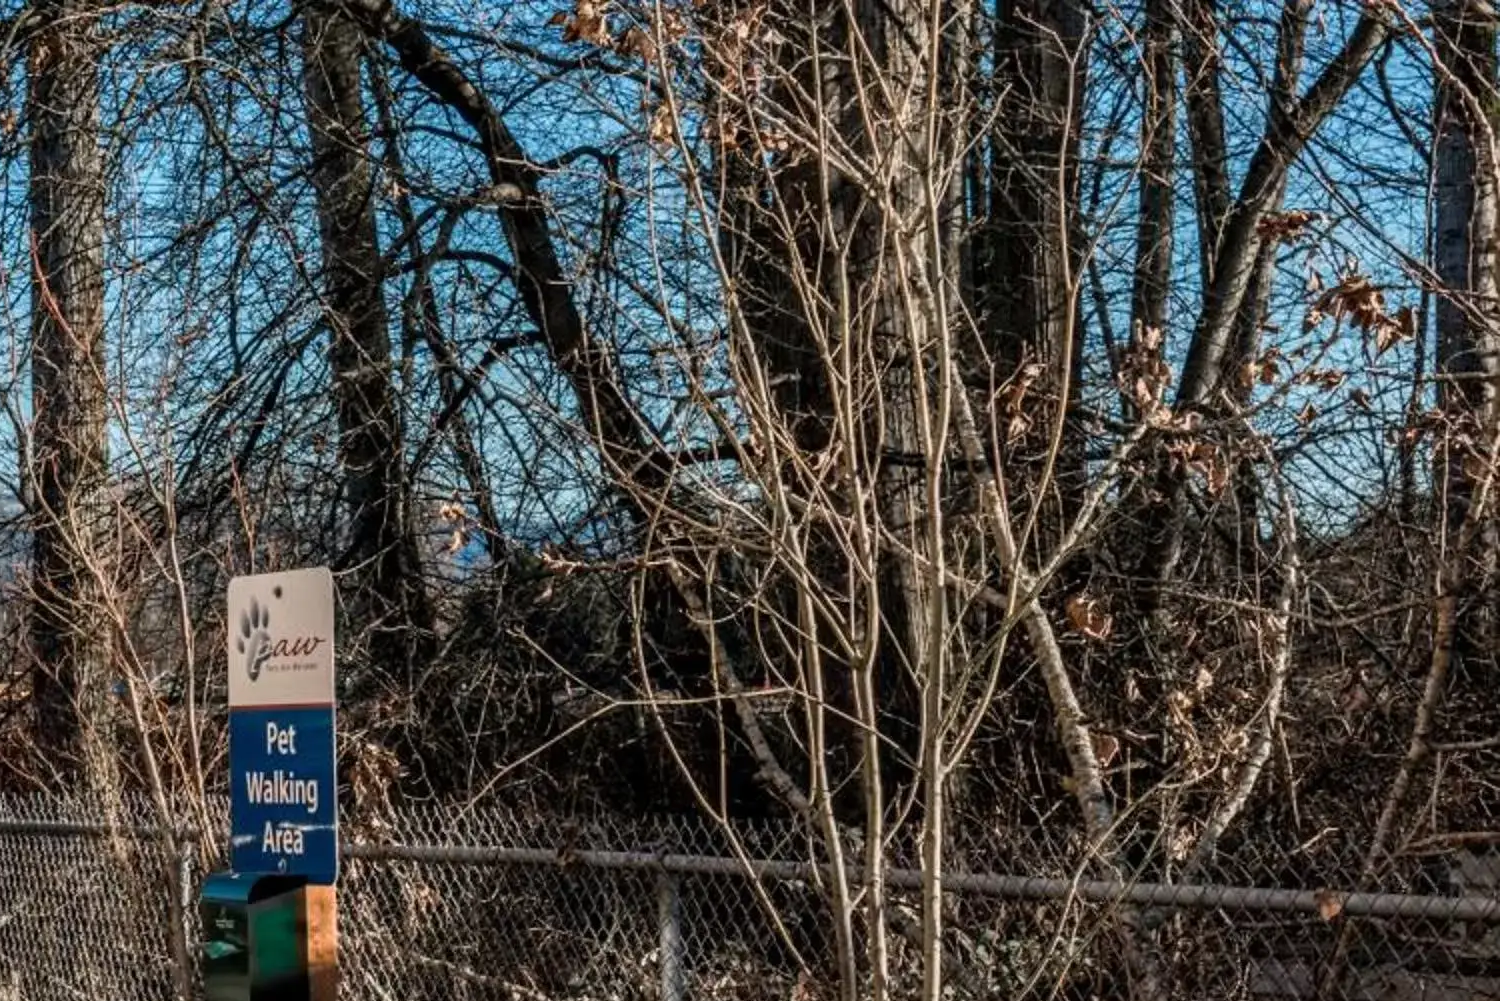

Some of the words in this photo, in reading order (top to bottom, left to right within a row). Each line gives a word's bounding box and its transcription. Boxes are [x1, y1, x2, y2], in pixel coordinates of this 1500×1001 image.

[267, 721, 297, 755] Pet
[245, 770, 319, 813] Walking
[262, 820, 304, 855] Area
